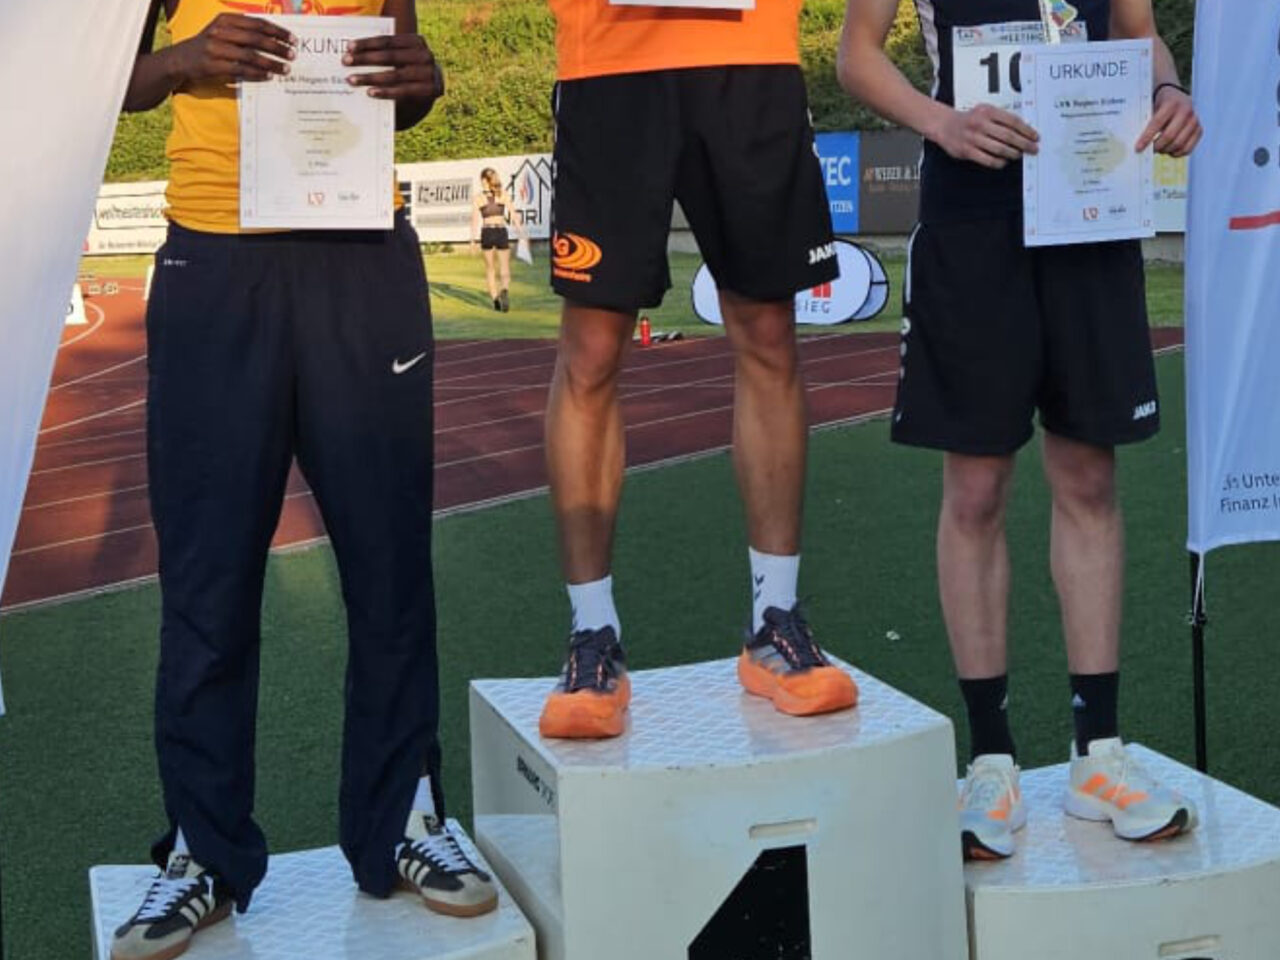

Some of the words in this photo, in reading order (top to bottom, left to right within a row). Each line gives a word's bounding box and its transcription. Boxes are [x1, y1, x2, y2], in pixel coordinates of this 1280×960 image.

[1050, 60, 1128, 80] URKUNDE
[809, 241, 836, 265] JAK
[1220, 497, 1270, 514] Finanz
